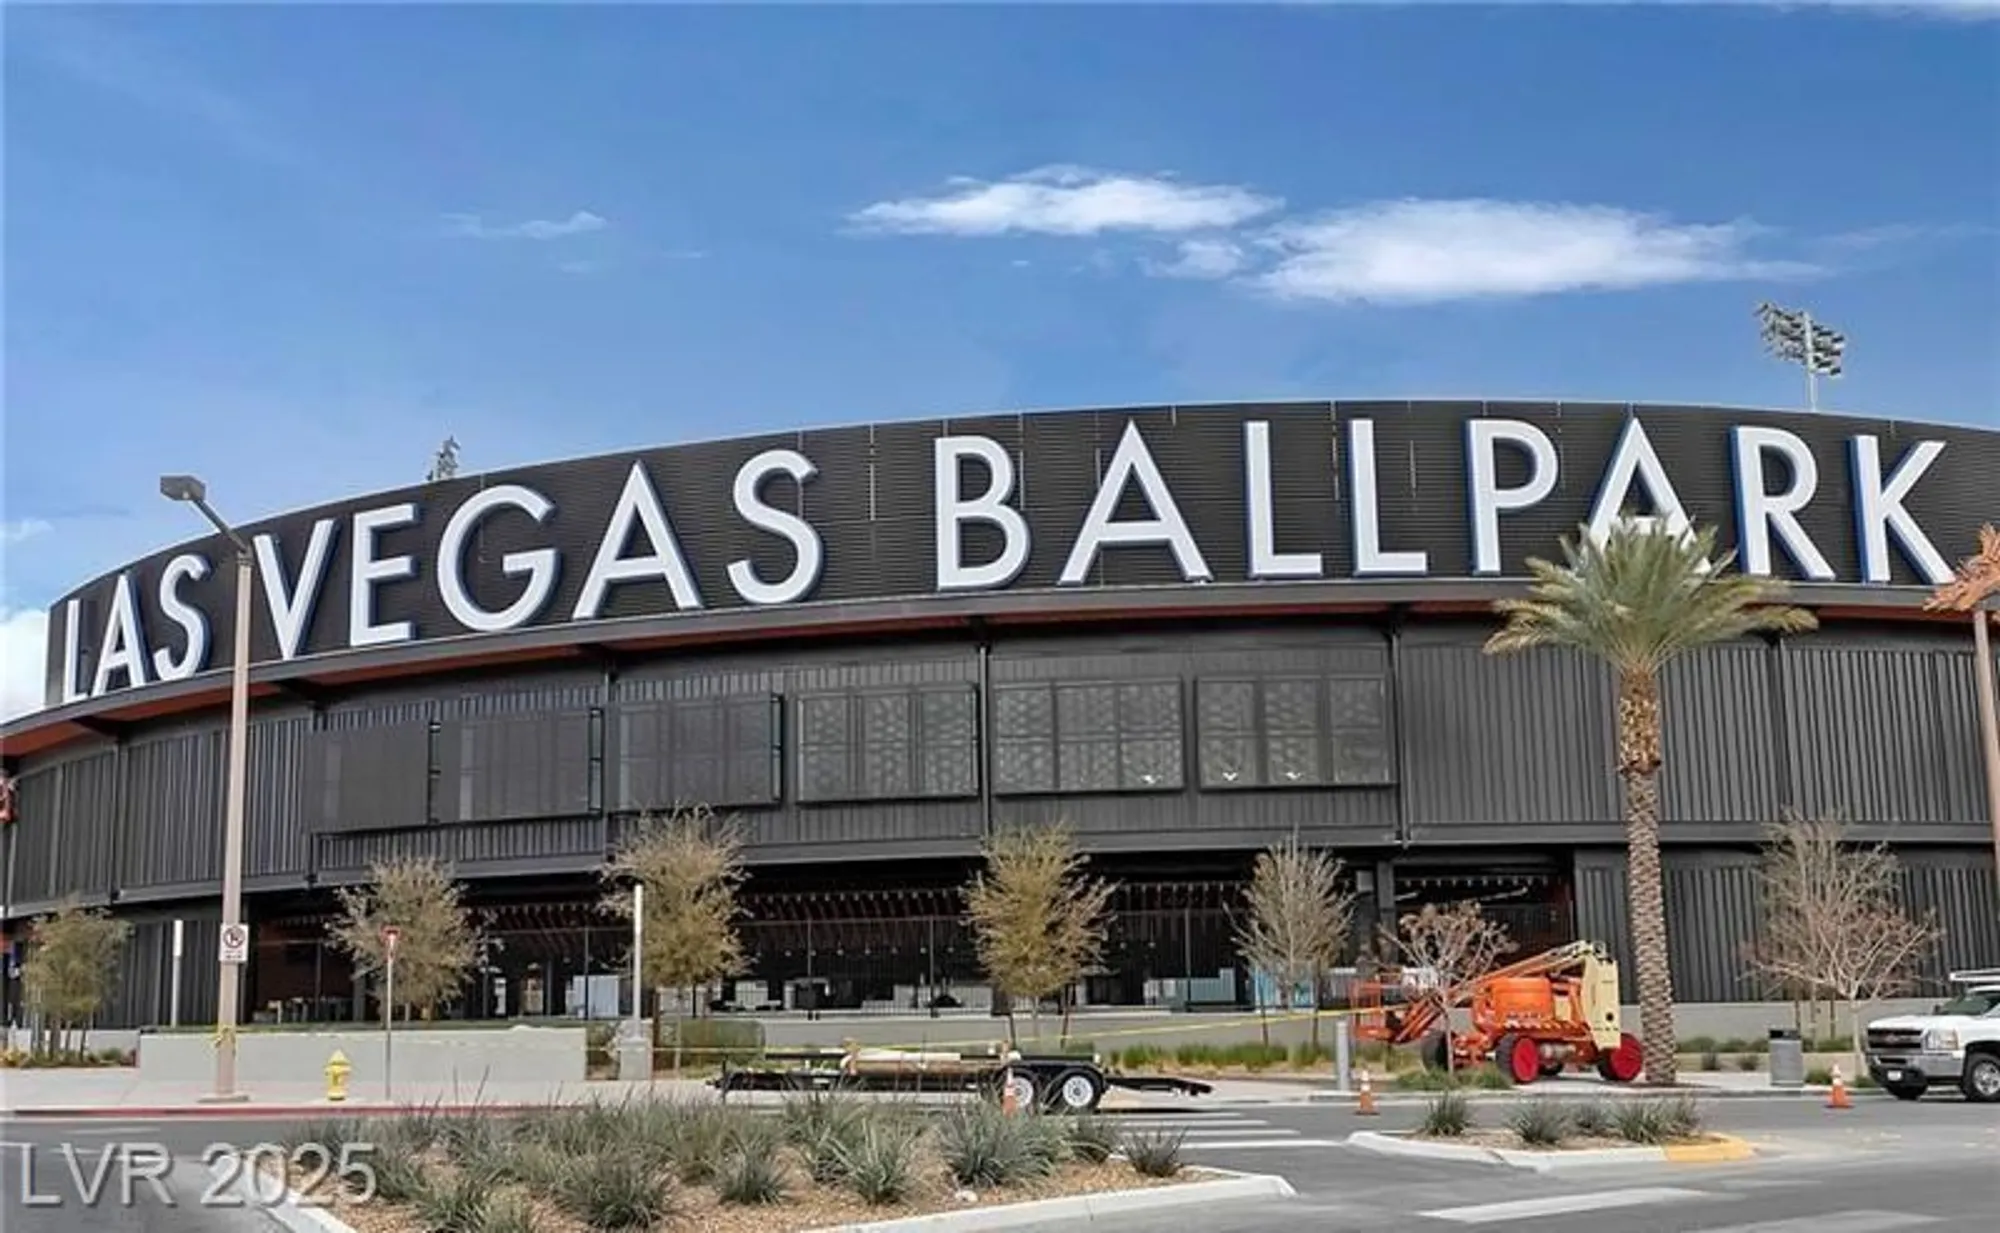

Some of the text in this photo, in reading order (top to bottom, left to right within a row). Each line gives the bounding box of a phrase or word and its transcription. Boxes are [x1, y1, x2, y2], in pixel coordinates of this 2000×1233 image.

[62, 417, 1956, 703] LAS VEGAS BALLPARK
